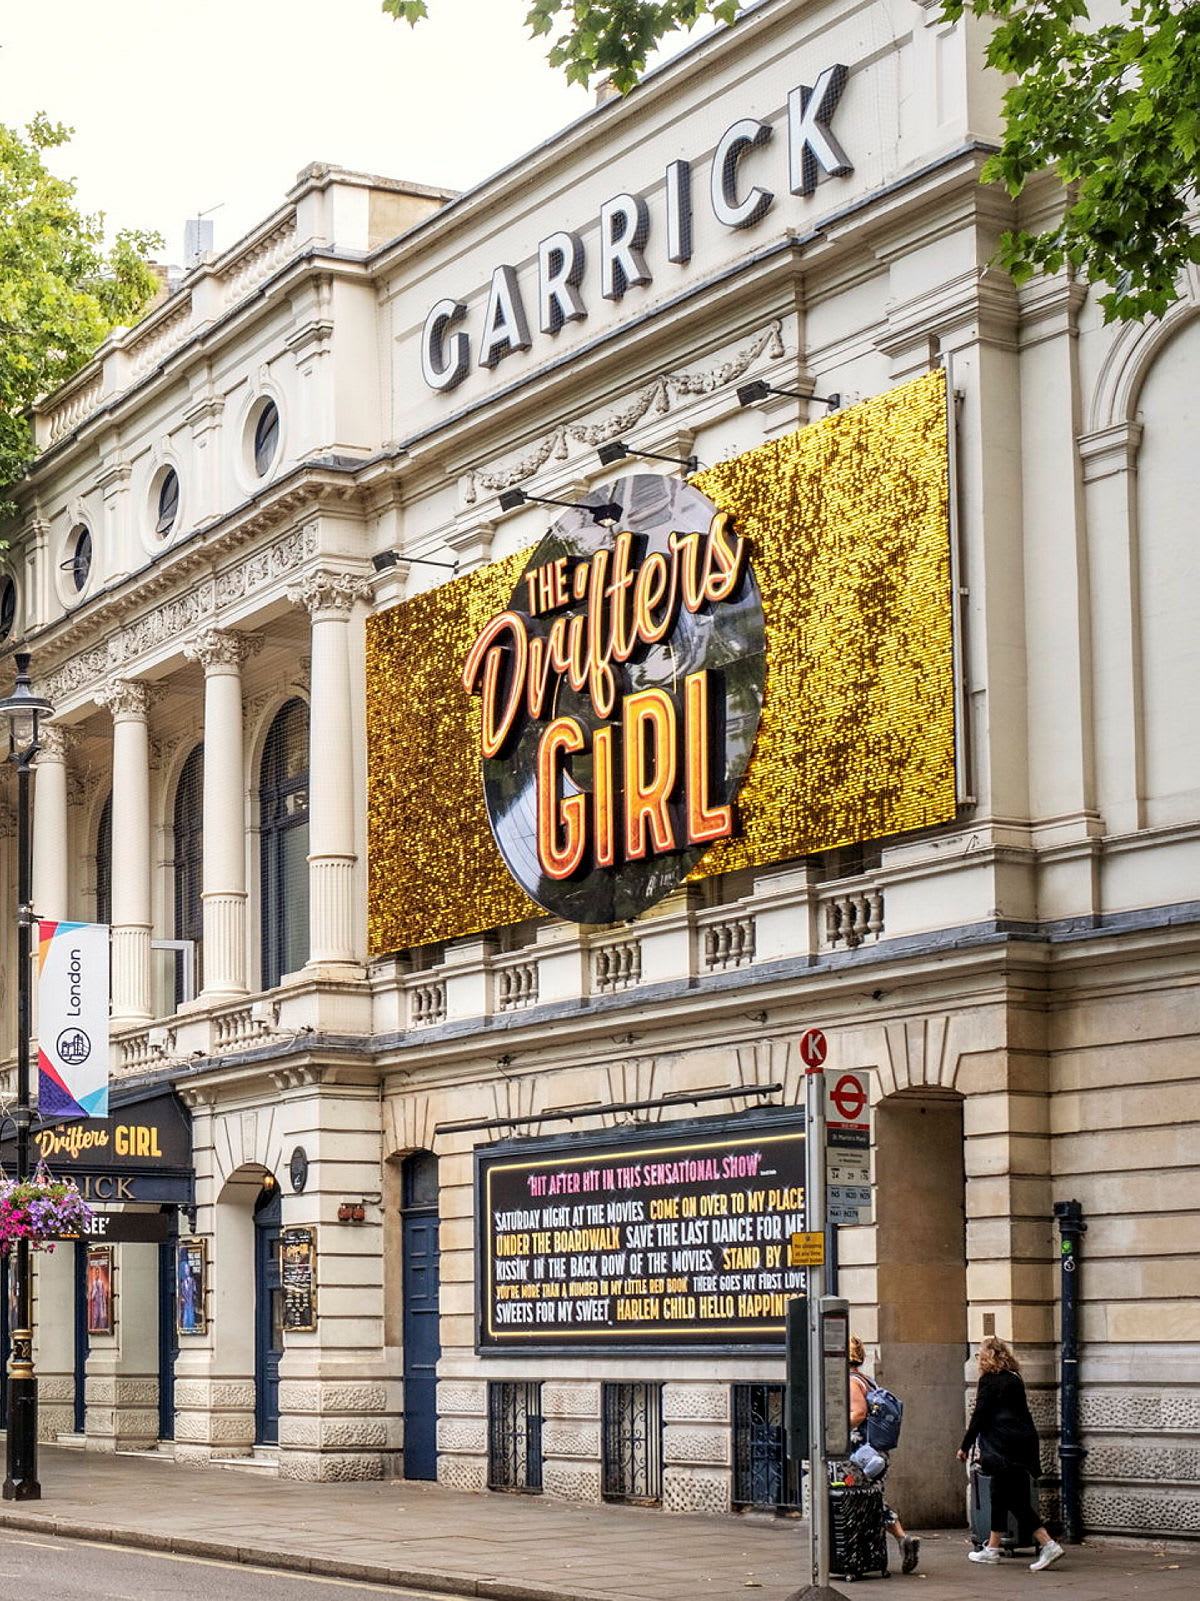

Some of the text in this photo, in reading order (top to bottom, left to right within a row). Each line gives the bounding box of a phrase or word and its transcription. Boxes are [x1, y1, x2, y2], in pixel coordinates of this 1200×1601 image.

[420, 63, 855, 392] GARRICK
[526, 556, 569, 617] THE
[462, 512, 745, 759] Drifters
[536, 669, 733, 880] GIRL
[67, 948, 81, 1017] London
[807, 1033, 823, 1060] K
[35, 1125, 162, 1159] Drifters GIRL
[549, 1173, 580, 1195] AFTER
[583, 1170, 600, 1191] HIT
[603, 1169, 614, 1190] IN
[617, 1166, 641, 1188] THIS
[643, 1158, 720, 1186] SENSATIONAL
[495, 1187, 805, 1231] SATURDAY NIGHT AT THE MOVIES COME ON OVER TO MY PLACE
[496, 1214, 805, 1256] UNDER THE BOARDWALK SAVE THE LAST DANCE FOR ME
[496, 1259, 530, 1281] KISSIN'
[533, 1258, 545, 1279] IN
[548, 1257, 567, 1279] THE
[570, 1256, 598, 1277] BACK
[602, 1254, 626, 1276] ROW
[630, 1253, 643, 1275] OF
[647, 1252, 668, 1274] THE
[672, 1249, 713, 1273] MOVIES
[723, 1246, 760, 1270] STAND
[766, 1245, 782, 1268] BY
[522, 1283, 541, 1299] MORE
[542, 1282, 560, 1298] THAN
[562, 1282, 568, 1297] A
[569, 1281, 598, 1297] NUMBER
[600, 1280, 608, 1296] IN
[611, 1279, 623, 1295] MY
[624, 1278, 647, 1294] LITTLE
[650, 1278, 664, 1294] RED
[666, 1277, 688, 1293] BOOK
[693, 1274, 718, 1292] THERE
[720, 1274, 741, 1291] GOES
[743, 1274, 757, 1290] MY
[758, 1273, 782, 1290] FIRST
[784, 1272, 806, 1288] LOVE
[496, 1293, 806, 1323] SWEETS FOR MY SWEET HARLEM CHILD HELLO HAPPIN
